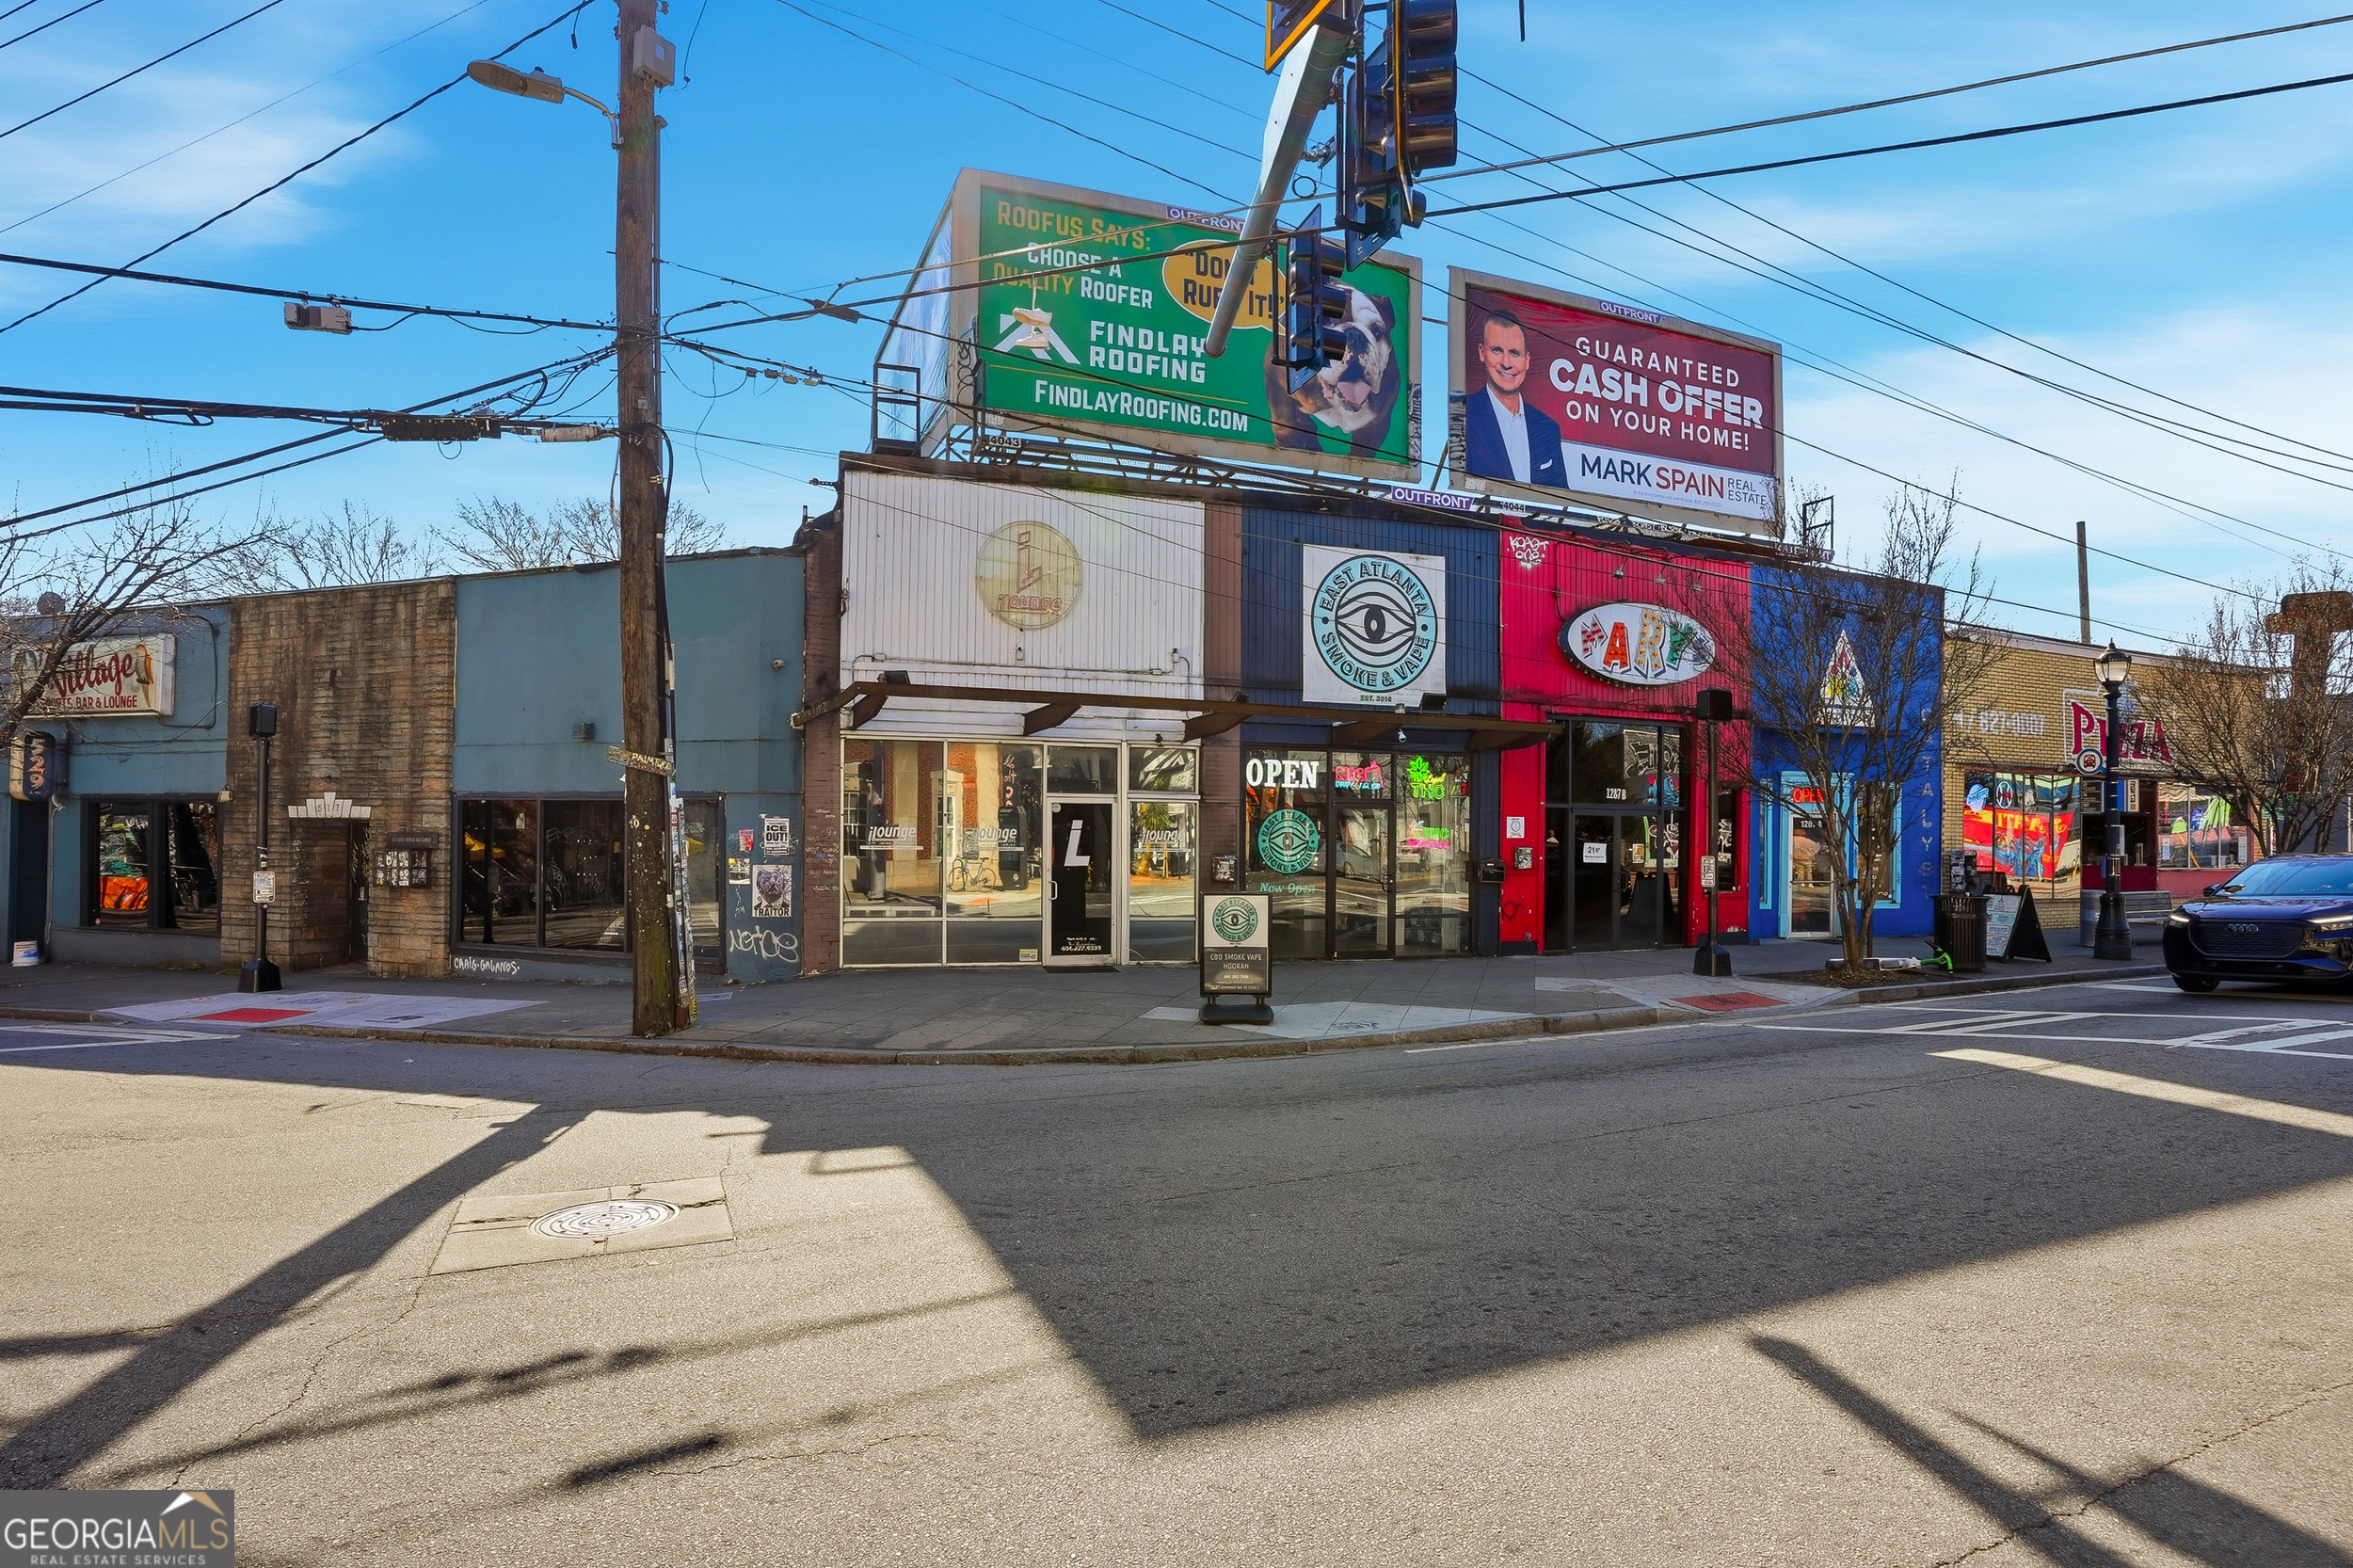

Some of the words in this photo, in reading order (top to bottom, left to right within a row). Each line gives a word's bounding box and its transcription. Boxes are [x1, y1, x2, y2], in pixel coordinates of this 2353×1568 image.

[998, 200, 1083, 240] ROOFUS
[1092, 217, 1151, 252] SAYS:
[1027, 240, 1103, 274] CHOOSE
[1109, 260, 1122, 278] A
[993, 261, 1074, 296] QUALITY
[1080, 276, 1153, 309] ROOFER
[1601, 301, 1659, 325] OUTFRONT
[1089, 320, 1208, 359] FINDLAY
[1089, 347, 1206, 384] ROOFING
[1575, 336, 1739, 387] GUARANTEED
[1548, 358, 1649, 408] CASH
[1657, 378, 1764, 430] OFFER
[989, 436, 1019, 447] 4043
[1565, 399, 1600, 424] ON
[1609, 408, 1672, 438] YOUR
[1680, 422, 1751, 452] HOME!
[1580, 452, 1652, 488] MARK
[1655, 466, 1725, 500] SPAIN
[1727, 477, 1757, 492] REAL
[1394, 488, 1471, 509] OUTFRONT
[1728, 490, 1769, 506] ESTATE
[1320, 567, 1354, 612] EAST
[1359, 561, 1430, 616] ATLANTA
[1321, 632, 1378, 688] SMOKE
[1381, 670, 1395, 687] &
[1393, 634, 1431, 681] VAPE
[75, 696, 94, 710] BAR
[95, 696, 102, 709] &
[103, 694, 138, 709] LOUNGE
[1245, 758, 1320, 789] OPEN
[766, 832, 788, 842] OUT!
[1259, 883, 1284, 893] Now
[1287, 882, 1316, 896] Open
[754, 906, 790, 918] TRAITOR
[1223, 962, 1250, 970] HOOKAH
